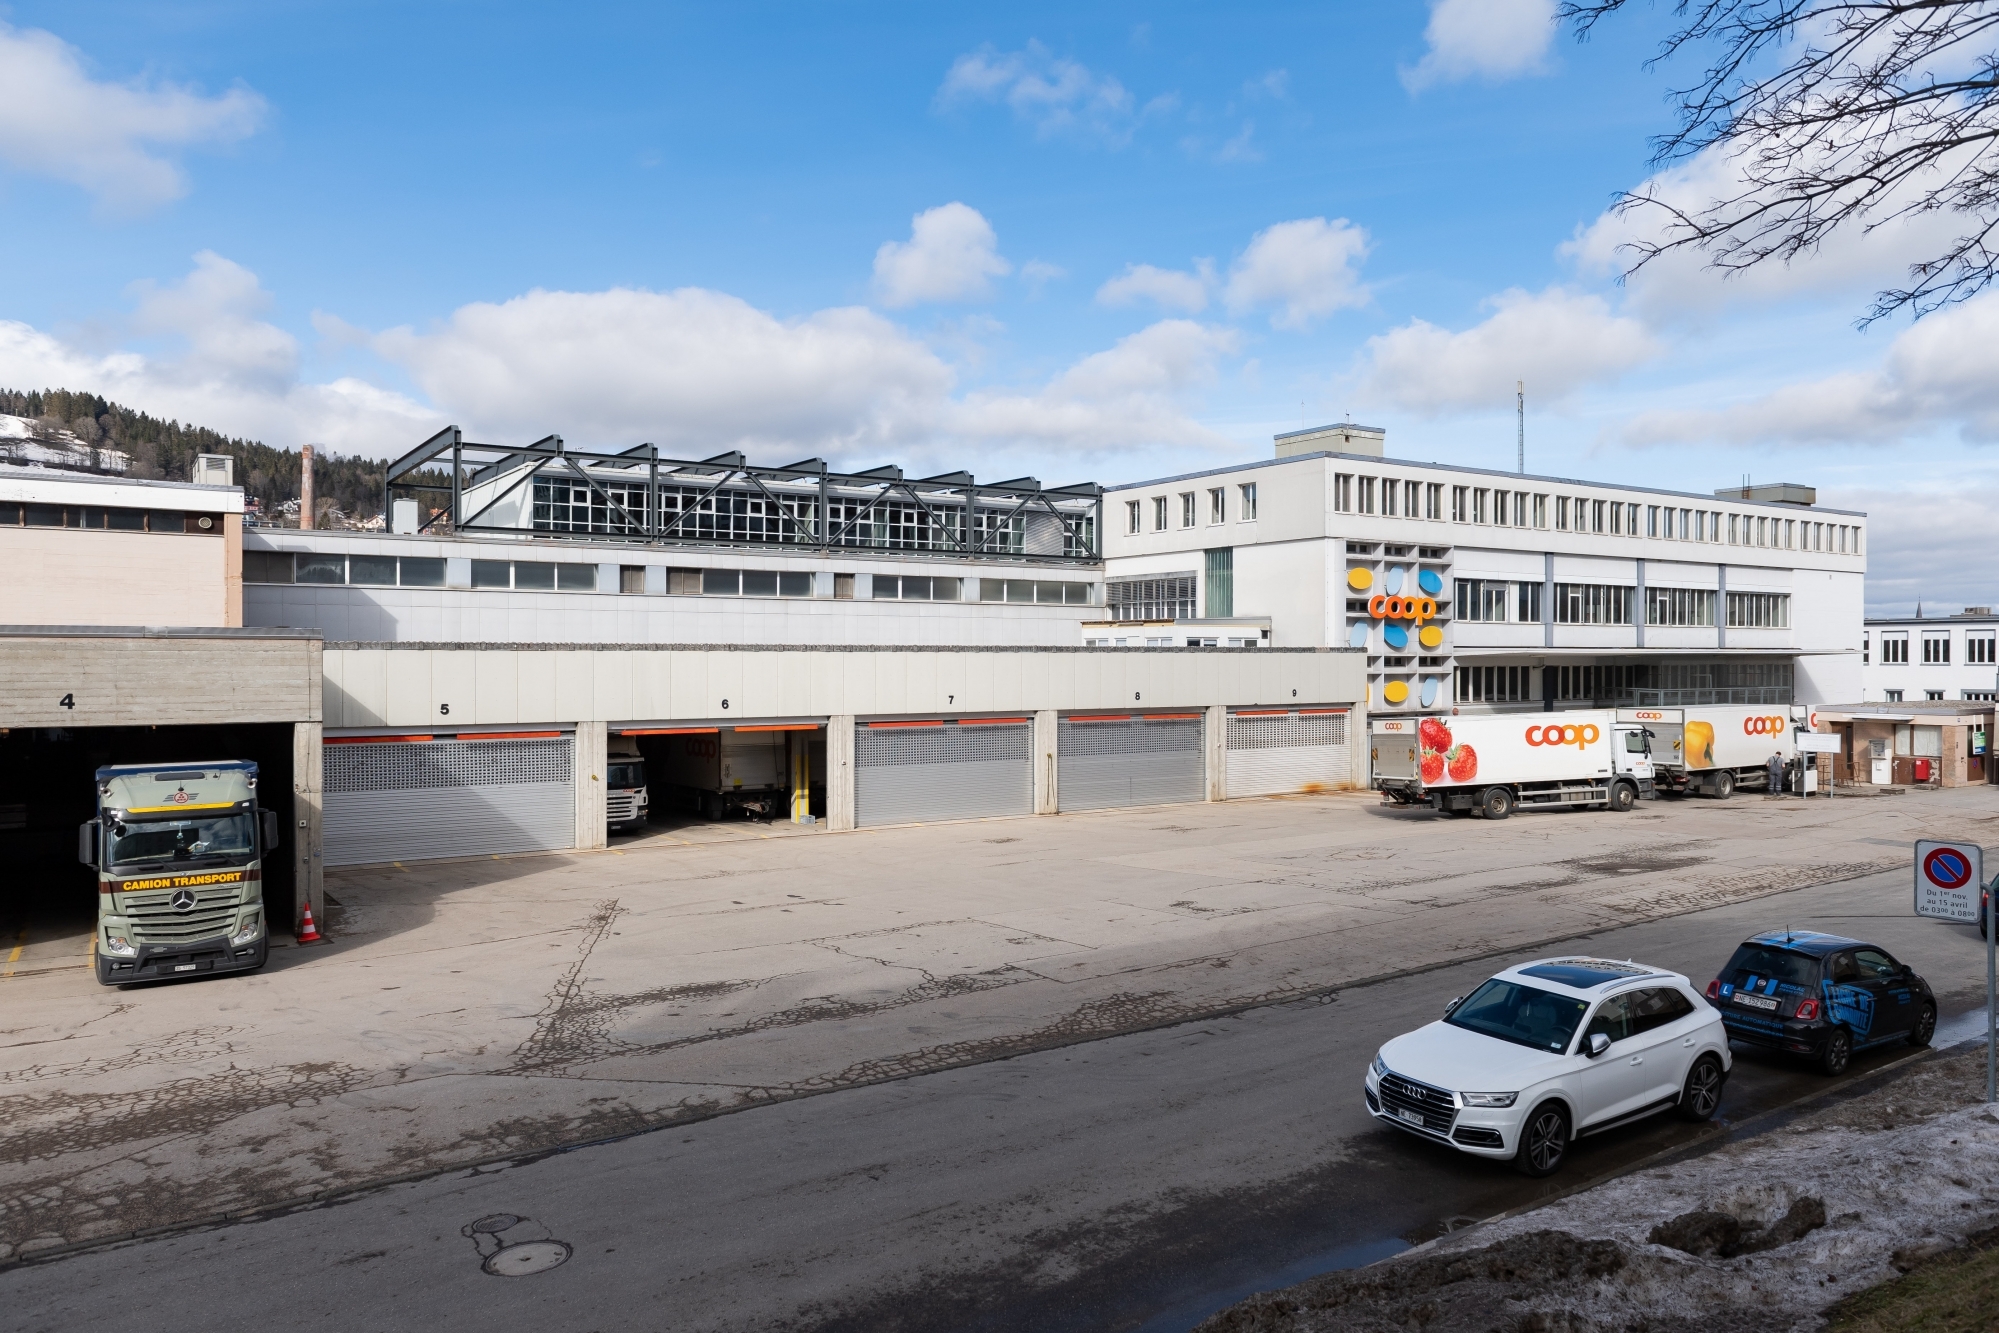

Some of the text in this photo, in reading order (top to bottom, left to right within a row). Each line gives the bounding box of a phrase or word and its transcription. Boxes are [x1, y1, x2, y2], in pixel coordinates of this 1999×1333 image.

[1368, 594, 1437, 626] coop
[1135, 691, 1141, 701] 8
[1292, 689, 1297, 697] 9
[60, 693, 76, 710] 4
[721, 699, 729, 710] 6
[948, 695, 955, 705] 7
[440, 703, 450, 716] 5
[1636, 711, 1662, 721] coop
[1384, 722, 1402, 732] coop
[1743, 715, 1785, 739] coop
[1524, 723, 1600, 751] coop
[685, 737, 716, 764] coop
[123, 878, 171, 891] CAMION
[173, 872, 242, 887] TRANSPORT
[1950, 901, 1968, 909] avril
[1722, 985, 1729, 995] L
[1858, 994, 1869, 1012] DE
[1742, 1015, 1784, 1030] AUTOMATIQUE
